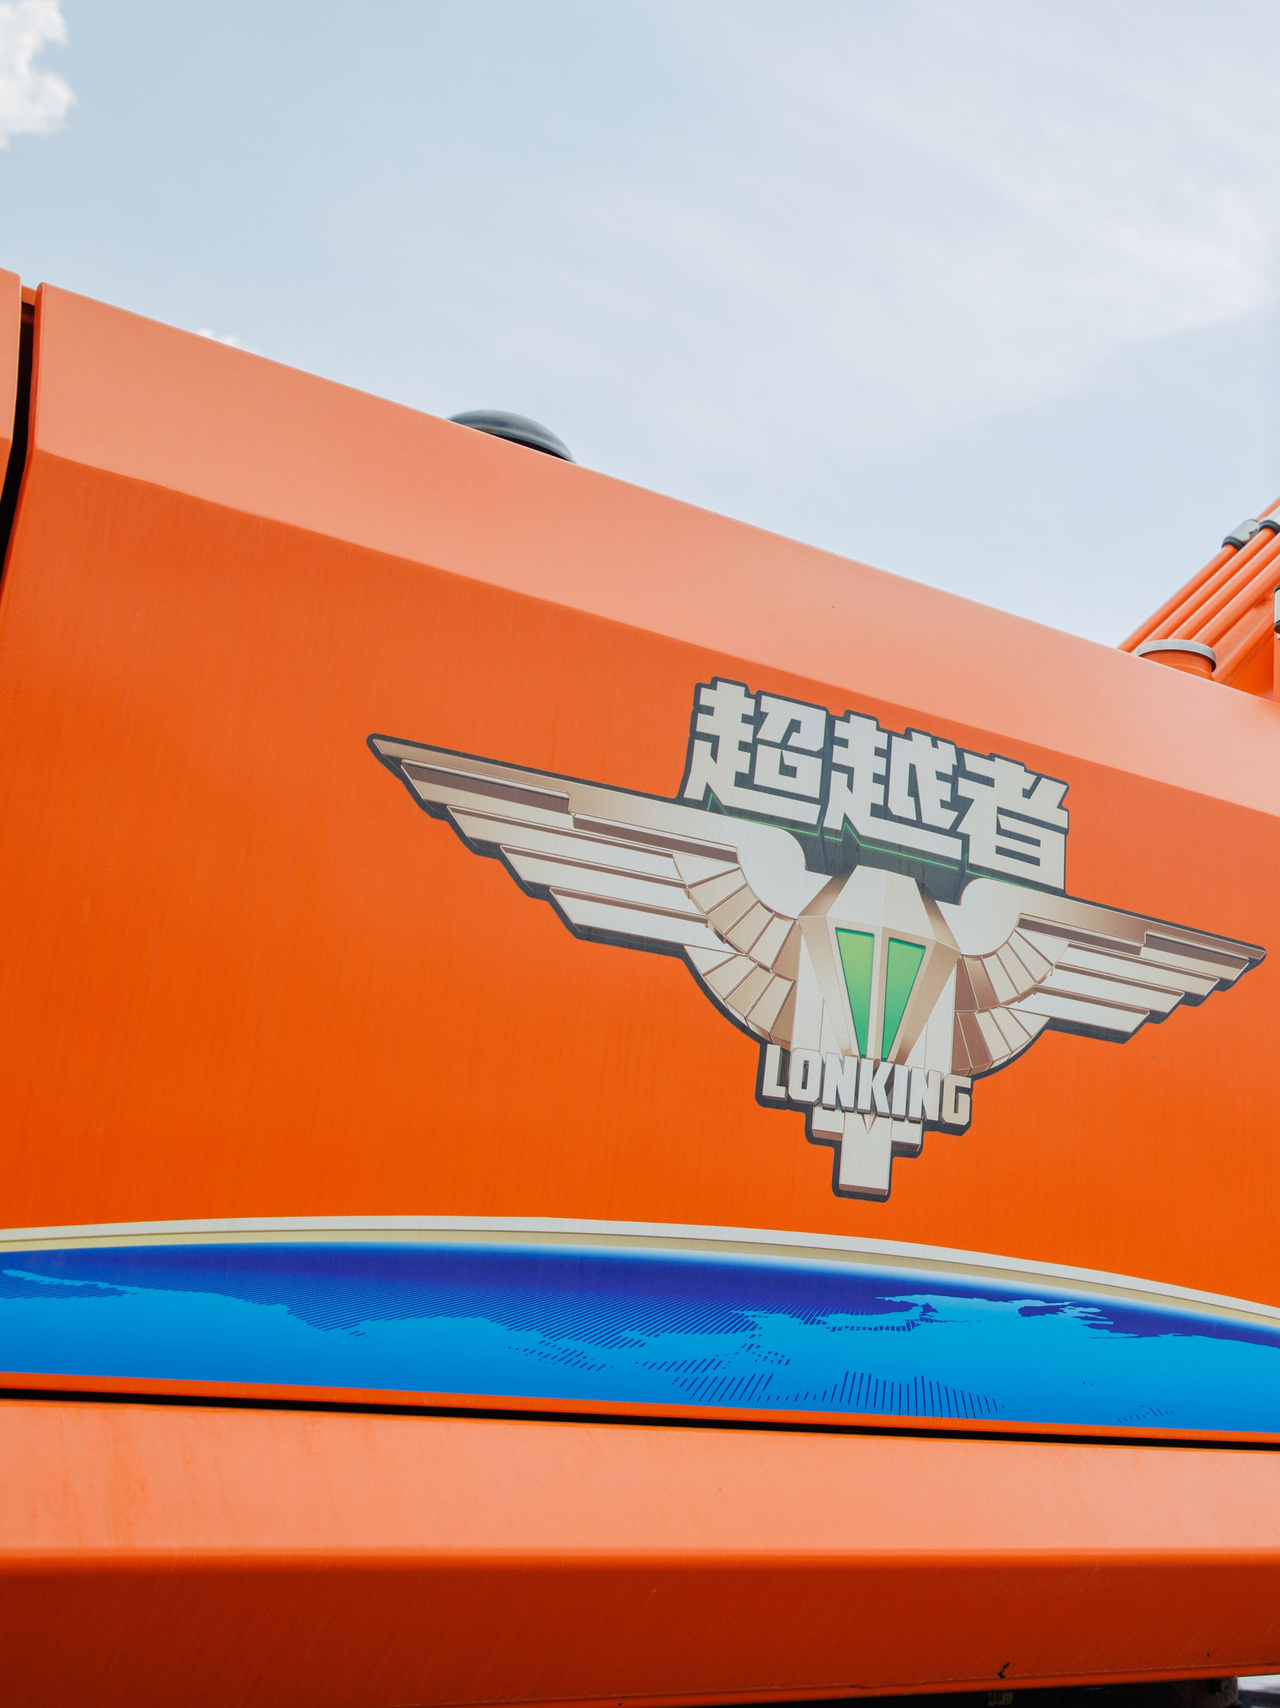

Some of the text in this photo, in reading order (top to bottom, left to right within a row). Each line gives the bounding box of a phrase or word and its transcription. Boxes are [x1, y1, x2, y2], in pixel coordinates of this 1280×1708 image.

[683, 680, 1069, 890] 超越者
[761, 1043, 973, 1127] LONKING
